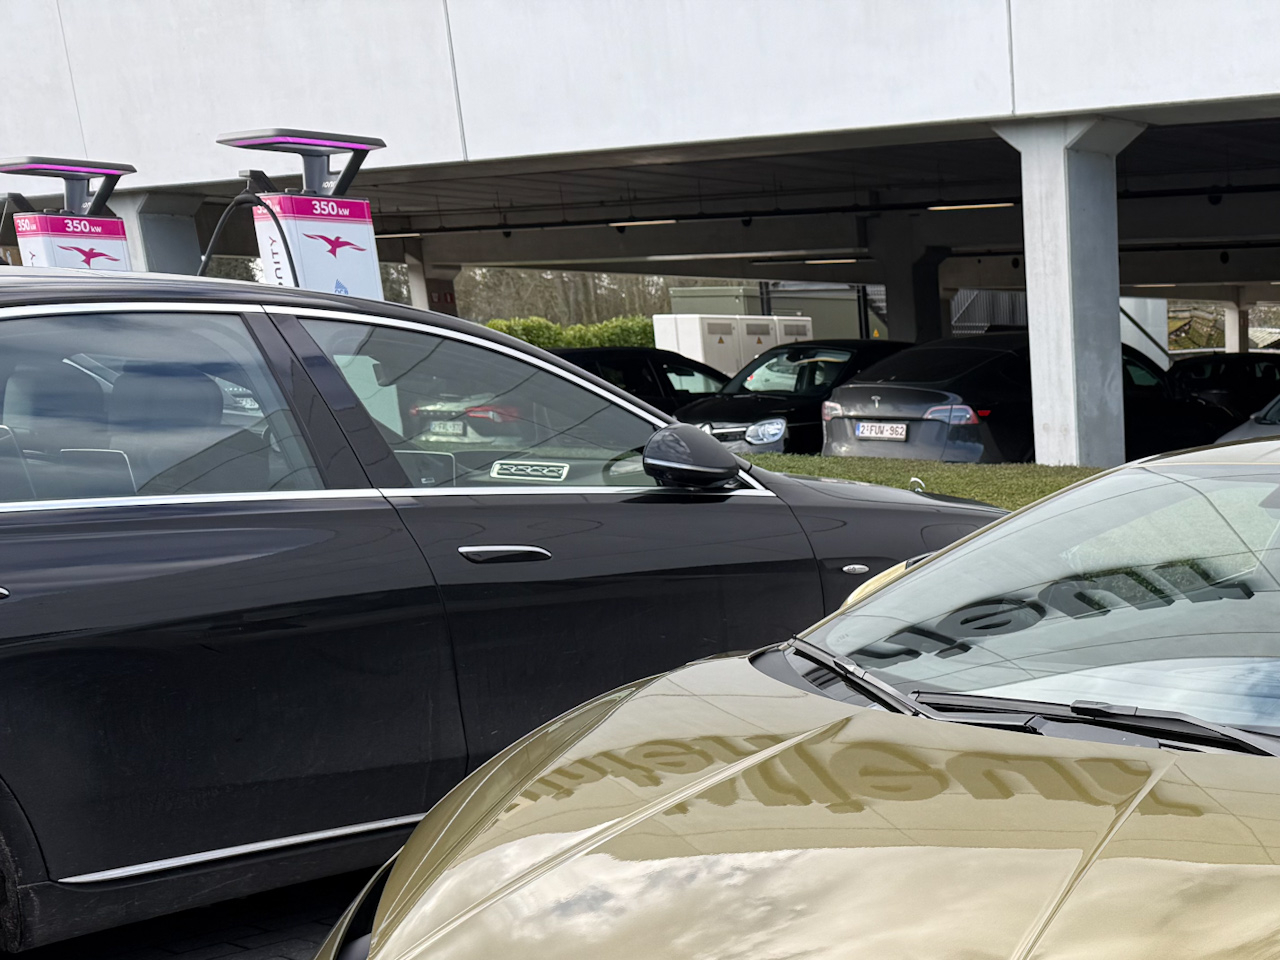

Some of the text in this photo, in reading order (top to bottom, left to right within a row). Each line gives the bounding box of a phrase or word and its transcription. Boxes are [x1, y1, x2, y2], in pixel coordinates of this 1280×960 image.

[312, 201, 350, 216] 350 kW
[16, 219, 30, 231] 350
[64, 220, 90, 232] 350
